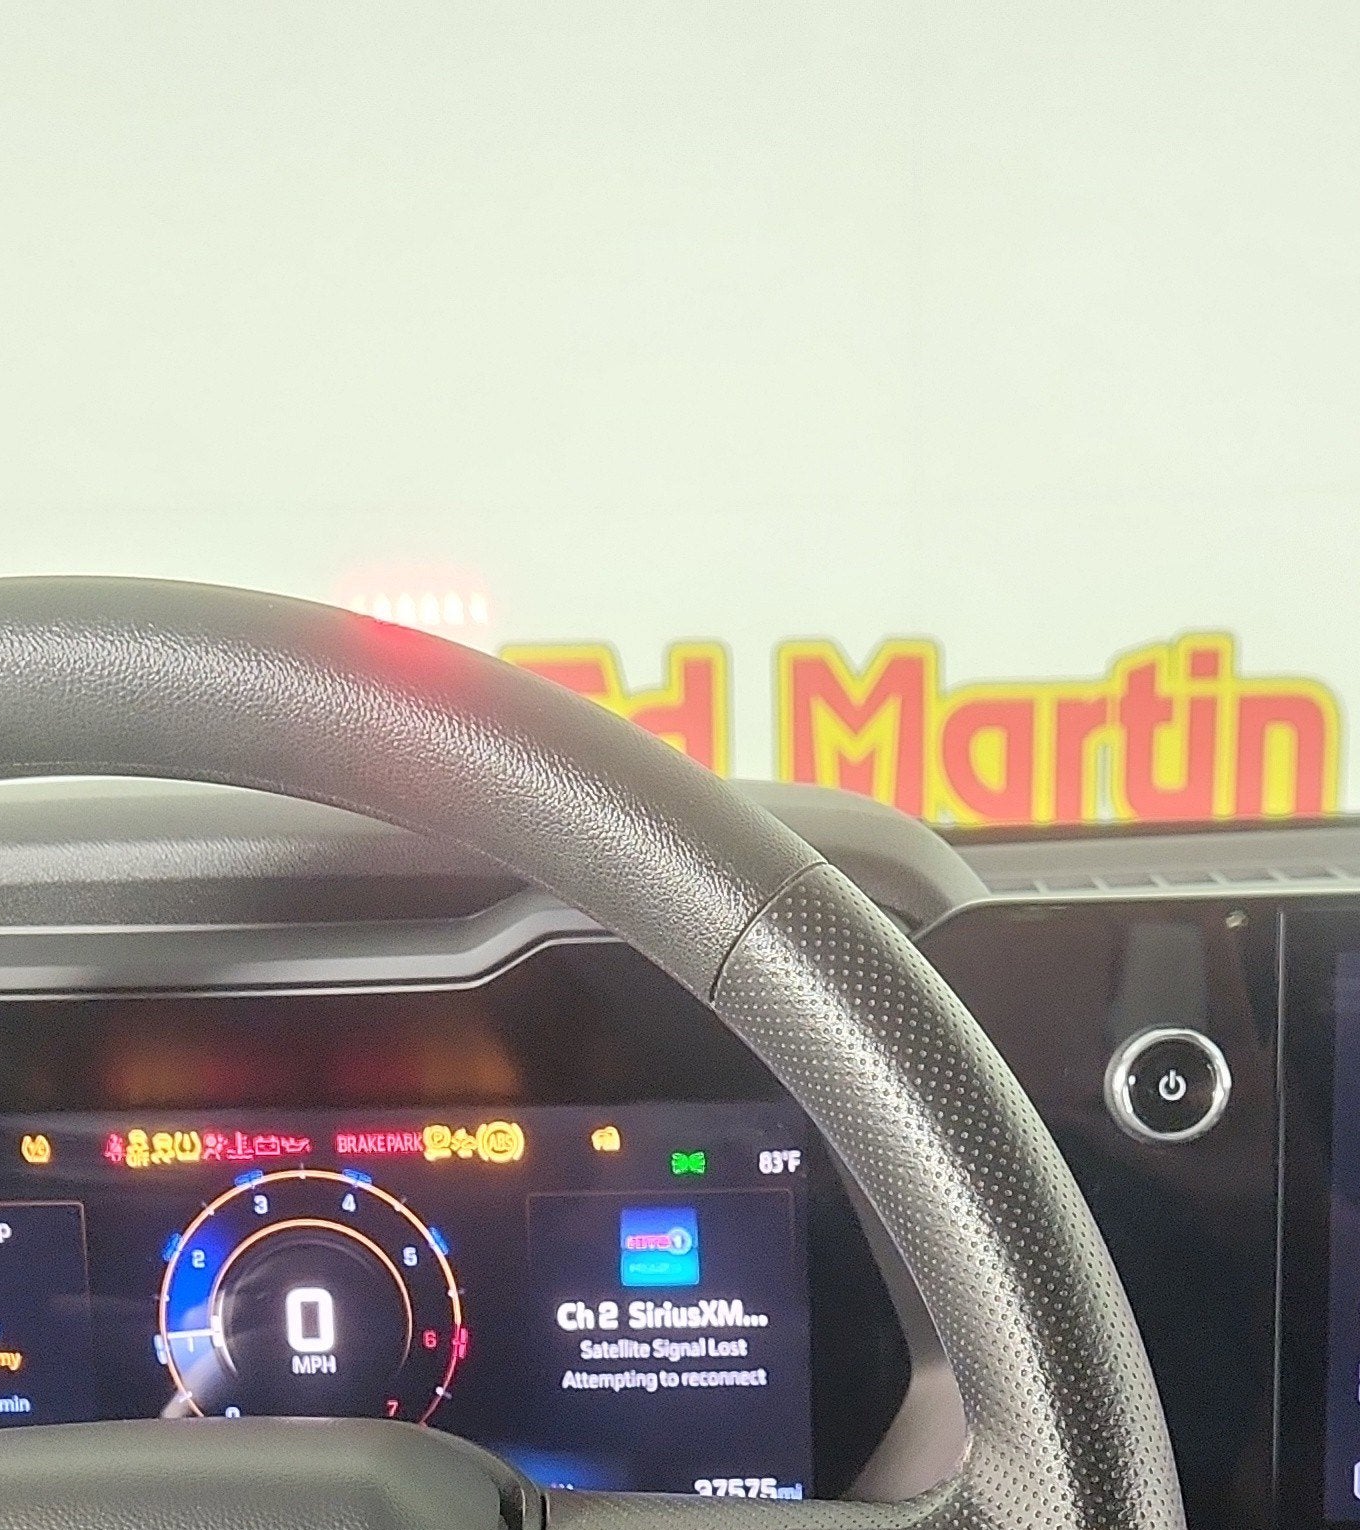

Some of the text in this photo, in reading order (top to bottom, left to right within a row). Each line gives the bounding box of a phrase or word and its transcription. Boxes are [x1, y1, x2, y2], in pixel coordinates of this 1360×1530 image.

[774, 631, 1345, 834] Martin
[337, 1133, 423, 1153] BRAKE PARK
[254, 1195, 268, 1214] 3
[286, 1287, 335, 1352] 0
[556, 1301, 595, 1330] Ch
[597, 1301, 619, 1330] 2
[580, 1337, 748, 1362] Satellite Signal Lost
[292, 1355, 337, 1374] MPH
[561, 1368, 768, 1392] Attempting to reconnect
